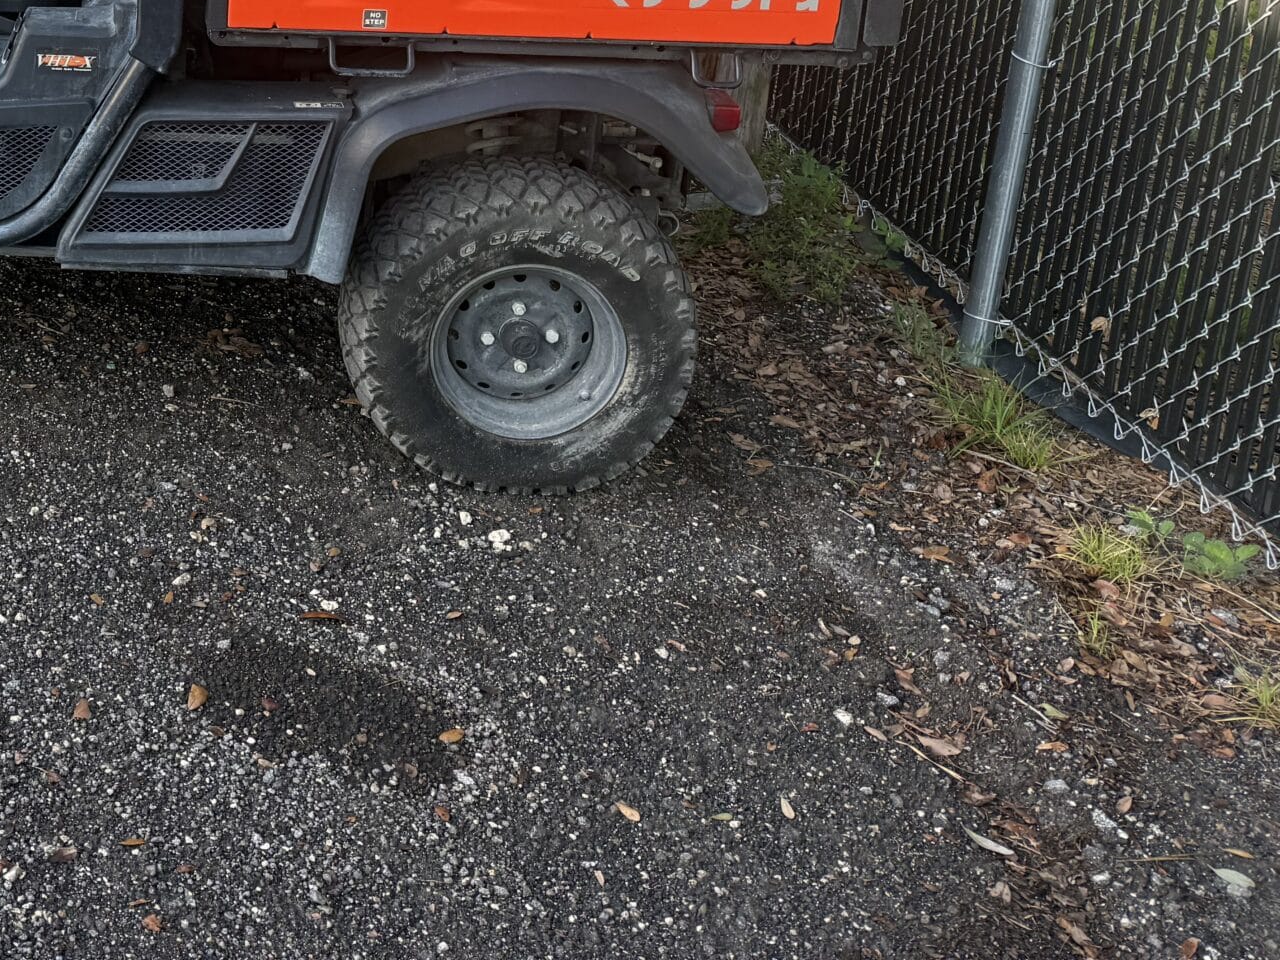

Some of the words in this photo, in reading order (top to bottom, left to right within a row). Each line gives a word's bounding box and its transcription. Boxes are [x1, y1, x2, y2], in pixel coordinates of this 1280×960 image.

[364, 18, 385, 26] STEP
[489, 229, 552, 247] OFF
[558, 231, 641, 282] ROAD
